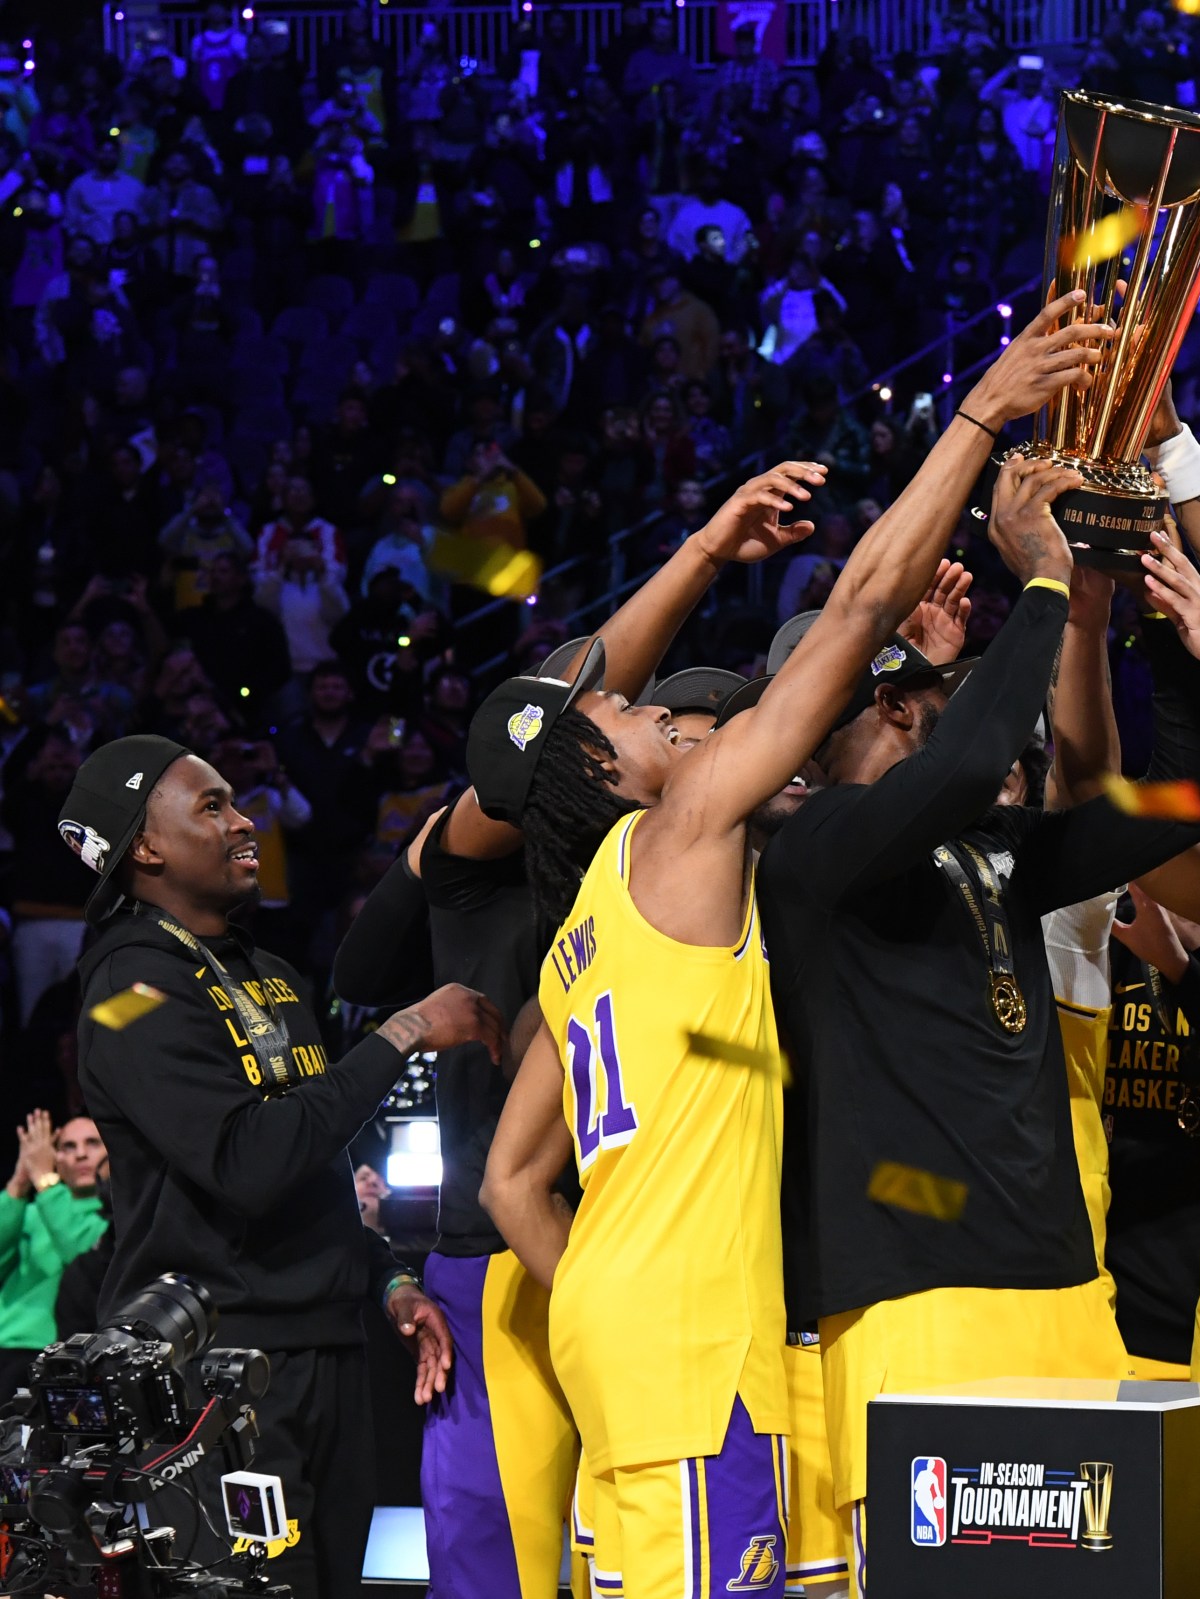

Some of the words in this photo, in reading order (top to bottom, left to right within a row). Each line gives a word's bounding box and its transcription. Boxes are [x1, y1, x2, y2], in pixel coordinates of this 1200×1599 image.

[1064, 508, 1083, 523] NBA
[1086, 512, 1131, 531] IN-SEASON
[959, 882, 987, 932] CHAMPIONS
[551, 915, 597, 994] LEWIS
[269, 1056, 290, 1084] PIONS
[1106, 1038, 1180, 1073] LAKER
[567, 988, 641, 1174] 21
[149, 1442, 205, 1491] RONIN
[980, 1462, 1044, 1487] IN-SEASON
[951, 1477, 1088, 1541] TOURNAMENT
[916, 1525, 933, 1540] NBA
